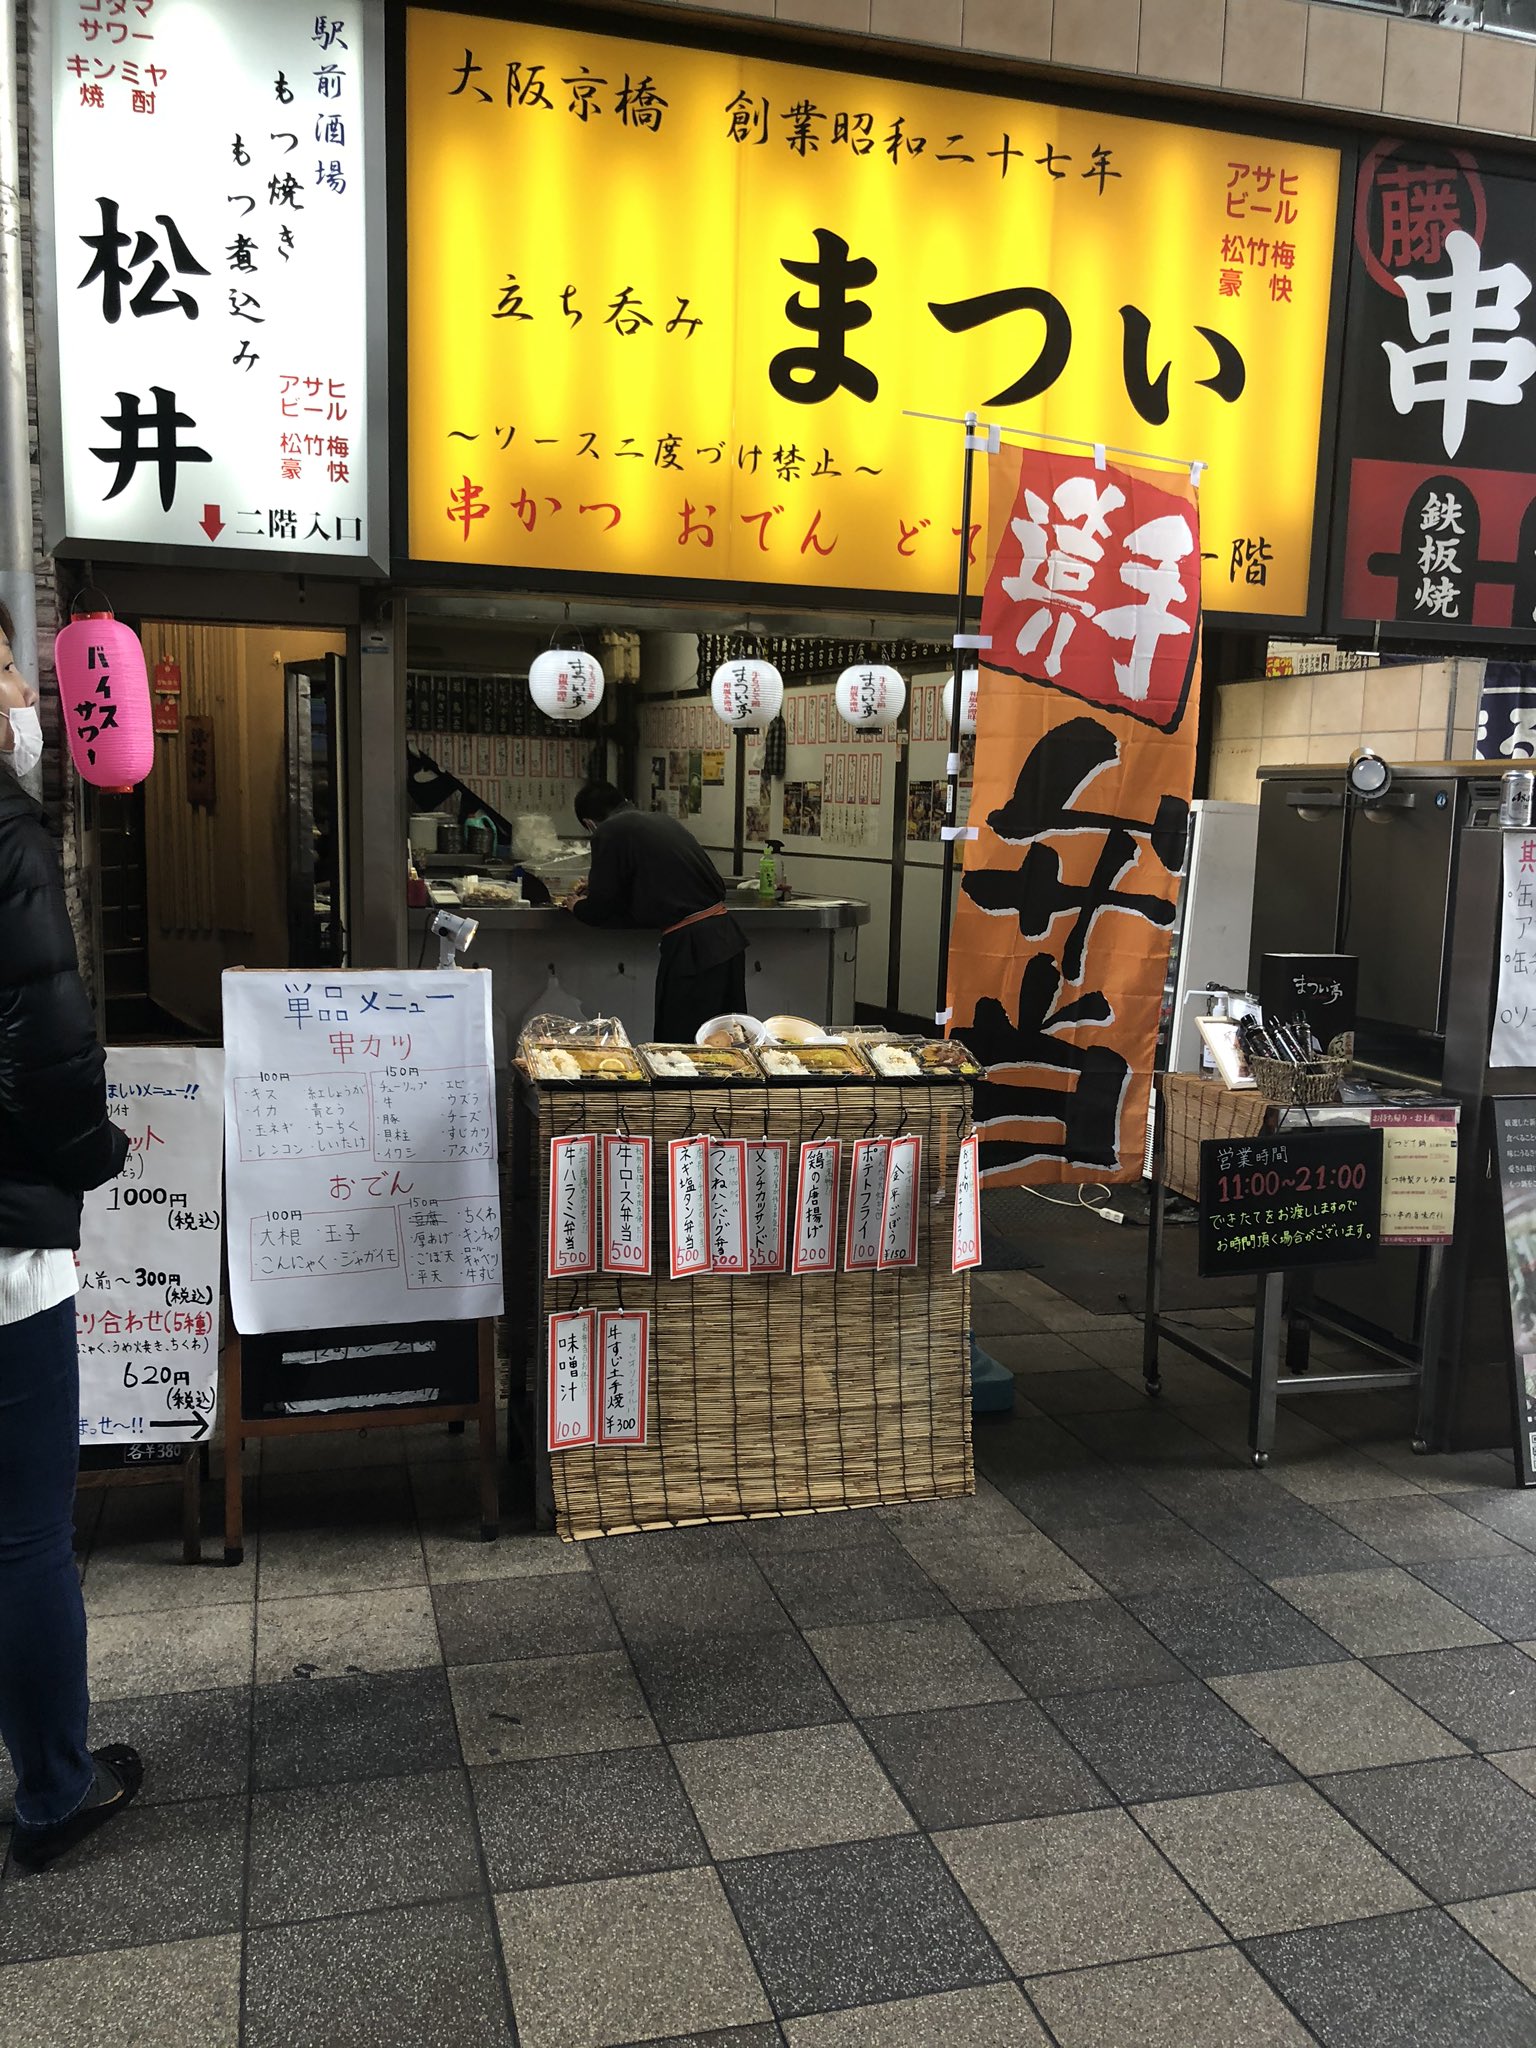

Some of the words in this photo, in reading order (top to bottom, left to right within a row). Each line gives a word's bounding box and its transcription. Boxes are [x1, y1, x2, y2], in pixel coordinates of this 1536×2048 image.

[79, 18, 155, 44] サワー
[66, 54, 167, 87] キンミヤ
[80, 83, 156, 115] 焼酎
[447, 47, 670, 133] 大阪京橋
[311, 16, 349, 195] 駅前酒場
[724, 89, 1123, 197] 創業昭和二十七年
[268, 70, 304, 262] もつ焼き
[1226, 162, 1300, 197] アサヒ
[1225, 191, 1299, 225] ビール
[1375, 163, 1464, 268] 藤
[224, 133, 266, 373] もつ煮込み
[1220, 234, 1297, 271] 松竹梅
[1218, 268, 1294, 304] 豪快
[490, 274, 704, 340] 立ち呑み
[768, 227, 1247, 427] まつい
[77, 197, 213, 513] 松井
[1381, 230, 1536, 460] 串
[279, 375, 346, 399] アサヒ
[280, 397, 348, 422] ビール
[280, 432, 350, 459] 松竹梅
[281, 457, 350, 484] 豪快
[446, 475, 623, 544] 串かつ
[235, 508, 363, 542] 二階入口
[676, 497, 839, 557] おでん
[1414, 491, 1466, 621] 鉄板焼
[88, 646, 119, 729] バイス
[731, 666, 752, 720] まつい亭
[859, 672, 877, 719] まつい亭
[73, 701, 99, 765] サワー
[1293, 974, 1344, 1005] まつい亭
[284, 983, 455, 1030] 単品メニュー
[330, 1031, 412, 1064] 串カツ
[260, 1071, 291, 1083] 100円
[385, 1066, 420, 1077] 150円
[446, 1079, 465, 1090] エビ
[251, 1087, 278, 1100] キス
[306, 1084, 367, 1101] 紅しょうが
[379, 1080, 429, 1094] チューリップ
[446, 1093, 480, 1106] ウズラ
[252, 1107, 278, 1118] イカ
[312, 1103, 346, 1119] 青とう
[447, 1109, 482, 1122] チーズ
[121, 1125, 165, 1151] ット
[255, 1122, 294, 1138] 玉ネギ
[383, 1128, 411, 1142] 貝柱
[447, 1126, 490, 1140] すじカツ
[258, 1143, 304, 1158] レンコン
[317, 1135, 367, 1152] しいたけ
[384, 1146, 417, 1160] イワシ
[447, 1142, 492, 1158] アスパラ
[1217, 1145, 1289, 1171] 営業時間
[330, 1170, 414, 1200] おでん
[563, 1146, 577, 1250] 牛ハラミ弁当
[616, 1144, 634, 1242] 牛ロース弁当
[679, 1146, 697, 1250] ネギ塩タン弁当
[806, 1150, 825, 1240] 鶏の唐揚げ
[857, 1146, 879, 1240] ポテトフライ
[106, 1186, 188, 1211] 1000円
[409, 1198, 439, 1208] 150円
[710, 1150, 731, 1256] つくねハンバーグ弁当
[755, 1149, 768, 1249] メンチカツサンド
[888, 1162, 905, 1245] 金平ごぼう
[168, 1209, 220, 1231] (税込)
[265, 1210, 303, 1222] 100円
[464, 1206, 498, 1224] ちくわ
[1208, 1199, 1358, 1231] できたてをお渡ししますので
[259, 1228, 303, 1247] 大根
[324, 1223, 362, 1243] 玉子
[412, 1231, 452, 1249] 厚あげ
[462, 1225, 501, 1243] キンチャク
[340, 1248, 398, 1269] ジャガイモ
[416, 1249, 456, 1265] ごぼ天
[558, 1250, 587, 1266] 500
[611, 1240, 642, 1261] 500
[676, 1246, 699, 1267] 500
[712, 1254, 738, 1266] 500
[749, 1249, 778, 1266] 350
[800, 1248, 826, 1262] 200
[853, 1243, 876, 1260] 100
[883, 1248, 907, 1262] ¥150
[260, 1255, 329, 1275] こんにゃく
[417, 1268, 443, 1284] 平天
[465, 1267, 495, 1283] 牛すじ
[165, 1285, 213, 1306] (税込)
[76, 1309, 213, 1336] り合わせ(5種)
[123, 1362, 190, 1389] 620円
[558, 1332, 580, 1402] 味噌汁
[607, 1324, 625, 1410] 牛すじ土手焼
[166, 1386, 216, 1414] (税込)
[557, 1421, 581, 1439] 100
[606, 1415, 636, 1435] ¥300
